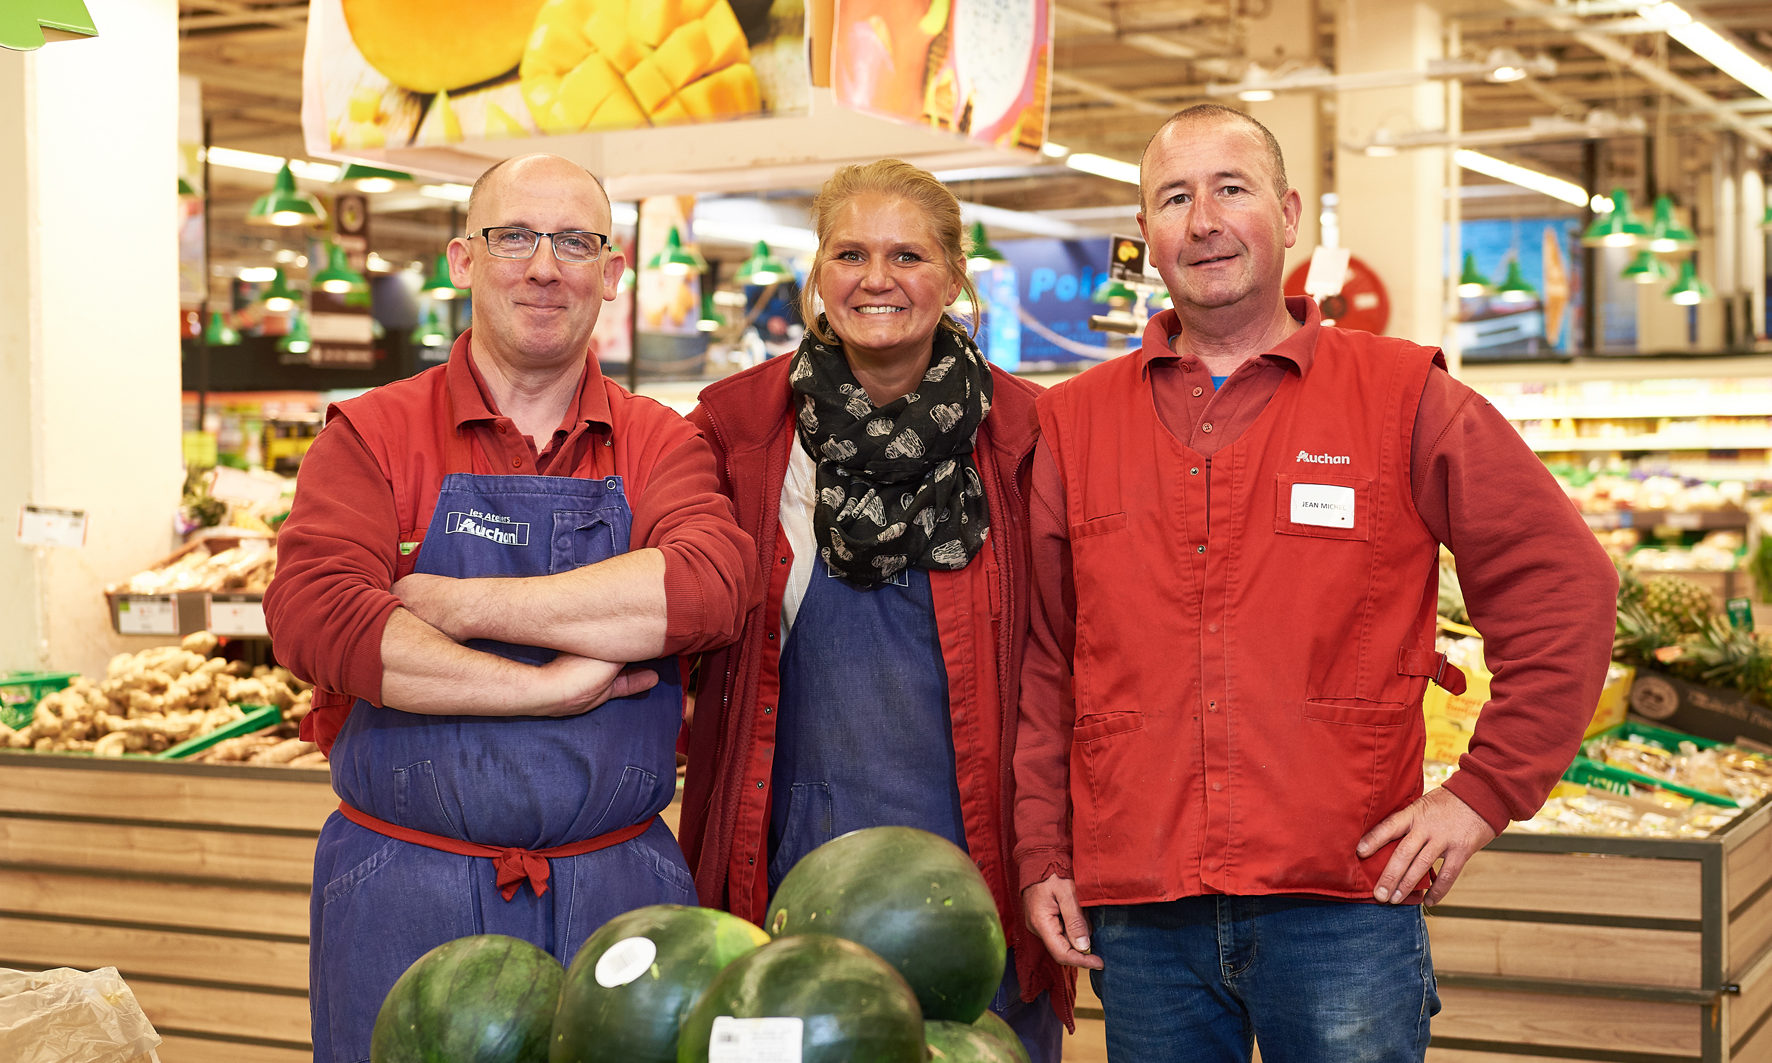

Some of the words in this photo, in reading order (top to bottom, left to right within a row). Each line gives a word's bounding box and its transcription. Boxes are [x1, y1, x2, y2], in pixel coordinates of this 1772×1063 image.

[1296, 450, 1351, 465] Auchan
[1302, 501, 1319, 509] JEAN
[469, 508, 483, 518] les
[458, 518, 516, 544] Auchan
